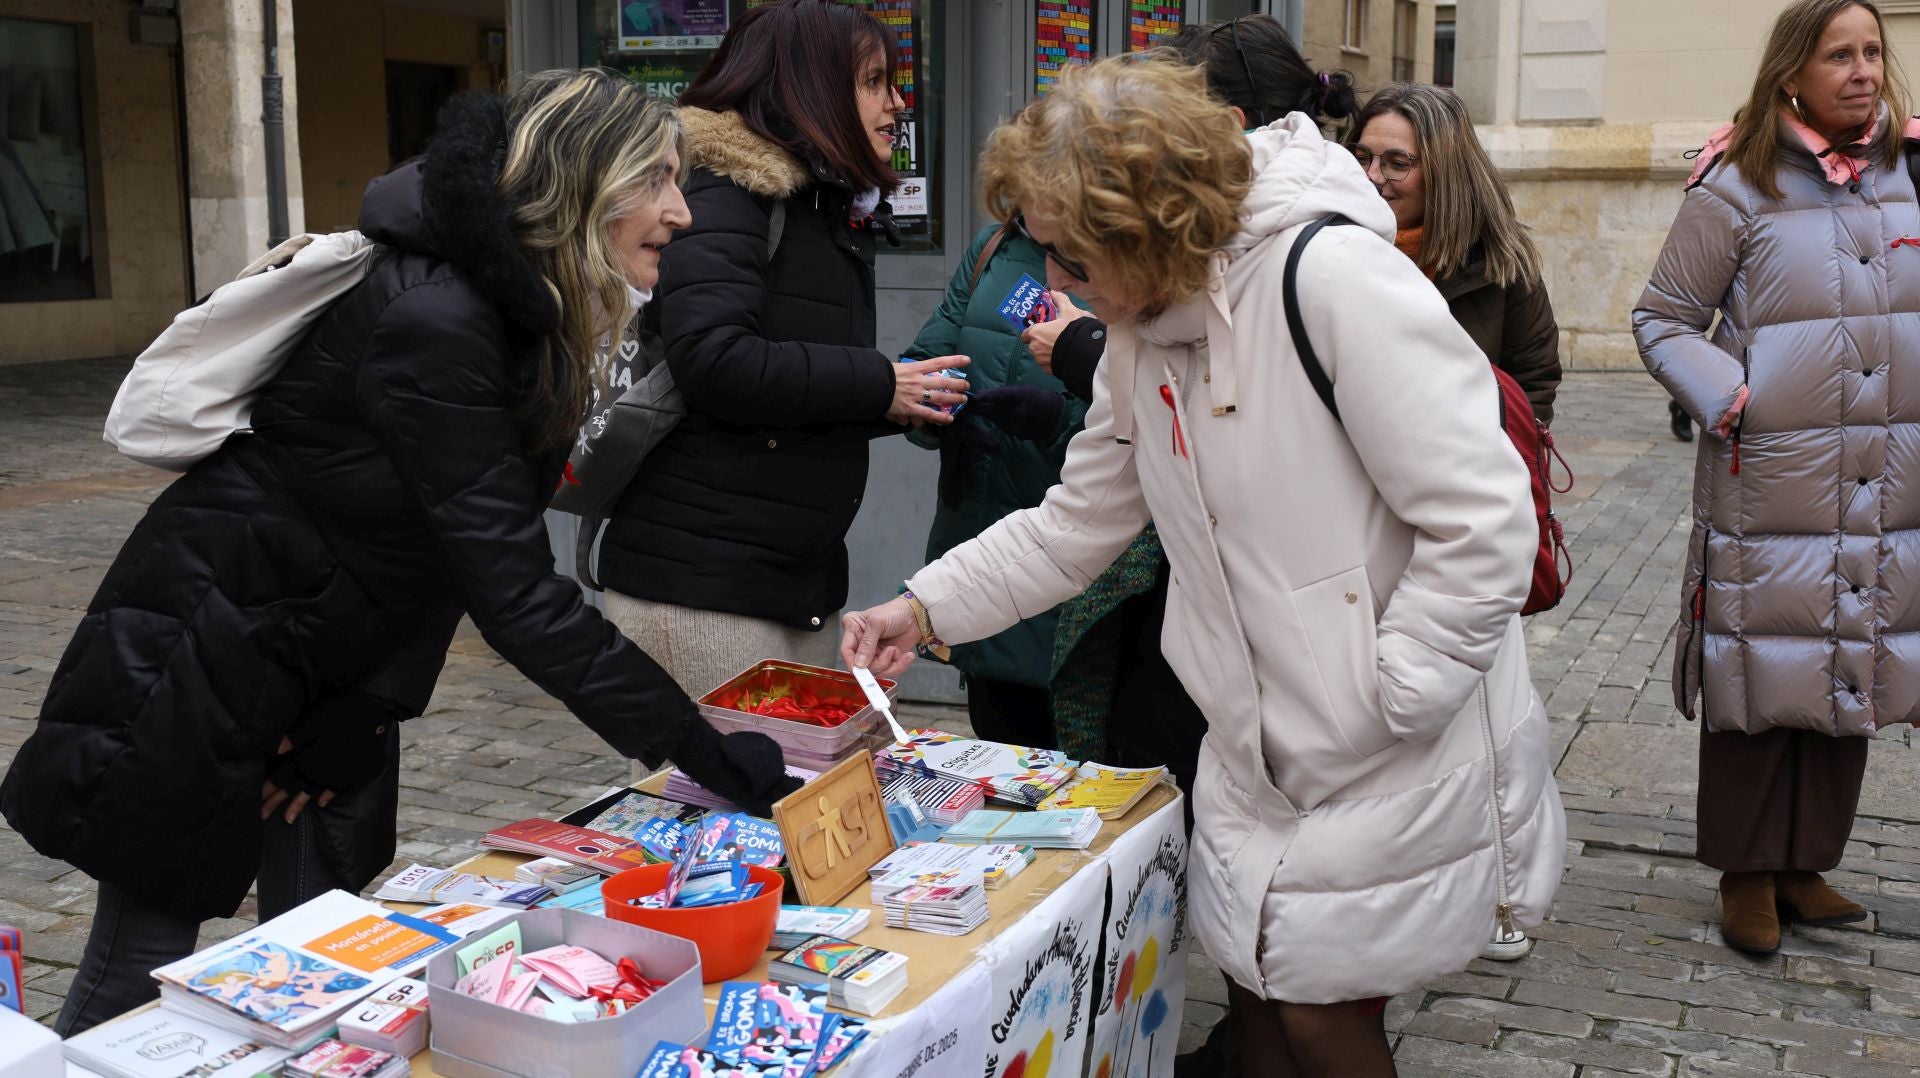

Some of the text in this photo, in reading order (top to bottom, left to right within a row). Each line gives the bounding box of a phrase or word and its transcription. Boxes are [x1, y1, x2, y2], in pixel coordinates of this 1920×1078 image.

[1016, 287, 1041, 318] GOMA
[735, 819, 746, 828] NO
[749, 823, 758, 832] ES
[736, 834, 780, 852] GOMA
[394, 868, 428, 887] VOTO
[325, 920, 393, 952] Montárselo
[720, 989, 738, 1023] BROMA
[734, 988, 758, 1046] GOMA
[937, 1028, 958, 1056] 2025
